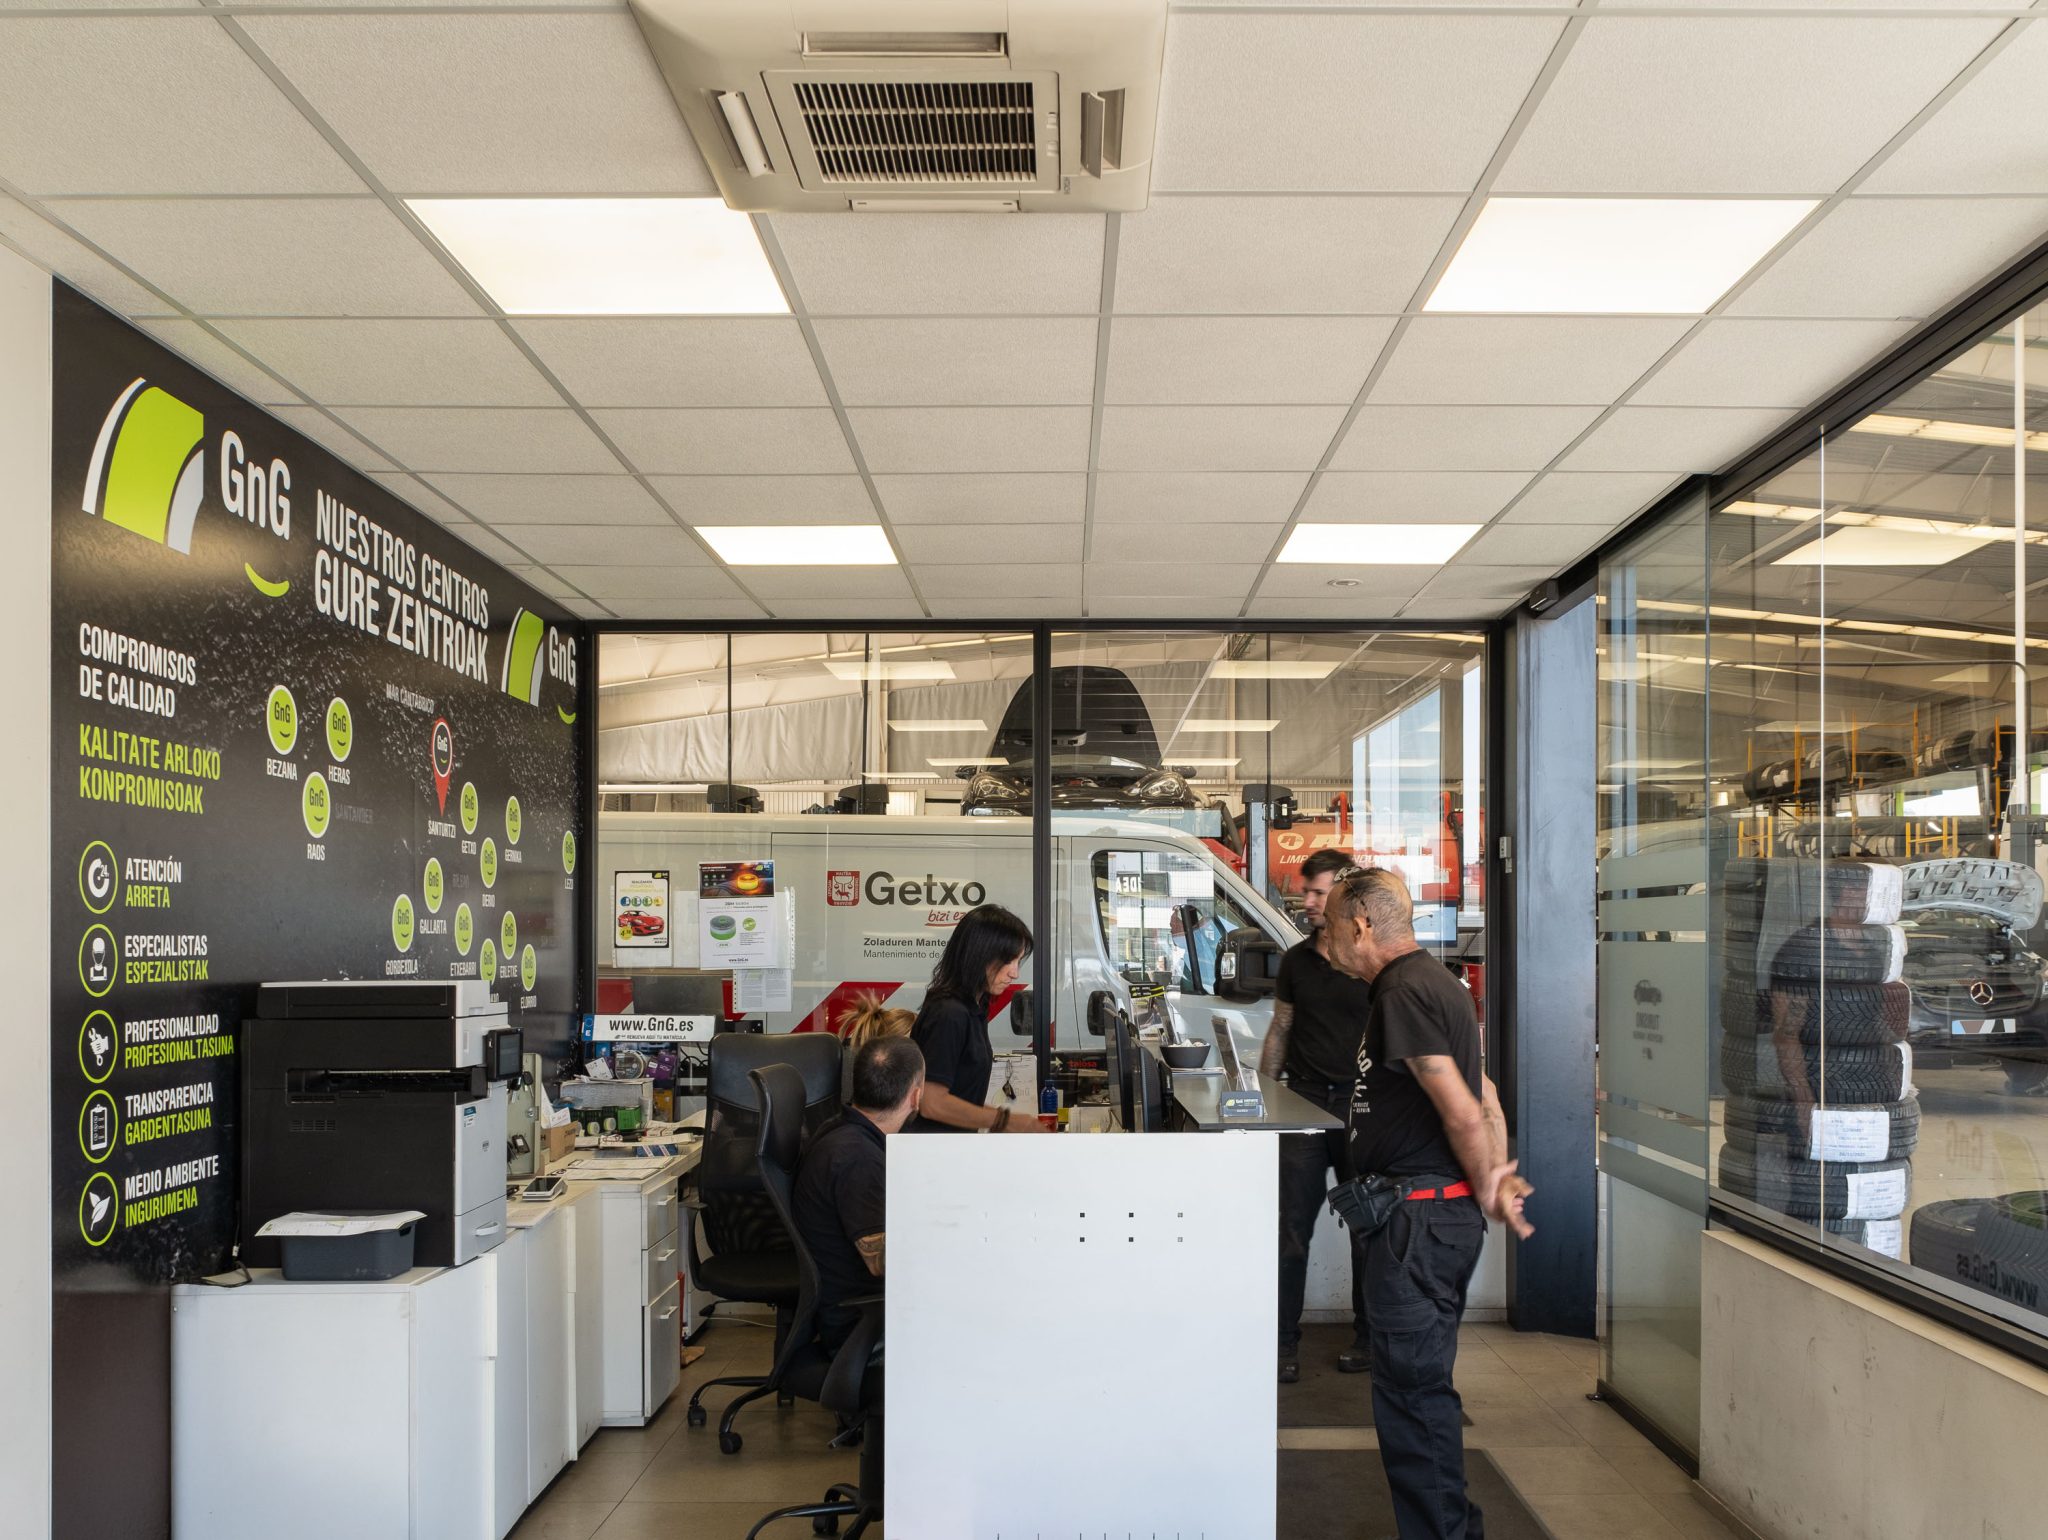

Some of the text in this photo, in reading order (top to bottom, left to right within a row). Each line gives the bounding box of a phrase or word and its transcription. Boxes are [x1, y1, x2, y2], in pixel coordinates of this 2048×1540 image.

[221, 430, 291, 541] GnG
[316, 489, 489, 629] NUESTROS CENTROS
[315, 549, 489, 684] GURE ZENTROAK
[79, 622, 197, 686] COMPROMISOS
[549, 626, 576, 687] GnG
[80, 664, 175, 718] DE CALIDAD
[274, 701, 291, 723] GnG
[332, 712, 347, 732] GnG
[79, 723, 221, 781] KALITATE ARLOKO
[266, 758, 298, 781] BEZANA
[328, 764, 351, 785] HERAS
[79, 765, 204, 815] KONPROMISOAK
[309, 787, 324, 808] GnG
[428, 820, 457, 838] SANTURTZI
[307, 843, 326, 861] RAOS
[125, 855, 182, 883] ATENCIÓN
[125, 884, 171, 908] ARRETA
[864, 870, 987, 907] Getxo
[419, 919, 447, 934] GALLARTA
[928, 909, 949, 922] bizi
[124, 935, 208, 958] ESPECIALISTAS
[863, 937, 950, 947] Zoladuren Mante
[863, 950, 927, 959] Mantenimiento
[125, 959, 209, 984] ESPEZIALISTAK
[385, 959, 419, 976] GORDEXOLA
[450, 961, 477, 977] ETXEBARRI
[125, 1013, 219, 1044] PROFESIONALIDAD
[609, 1017, 694, 1032] www.GnG.es
[125, 1034, 234, 1069] PROFESIONALTASUNA
[125, 1081, 214, 1118] TRANSPARENCIA
[125, 1107, 212, 1146] GARDENTASUNA
[125, 1154, 219, 1200] MEDIO AMBIENTE
[125, 1185, 199, 1228] INGURUMENA
